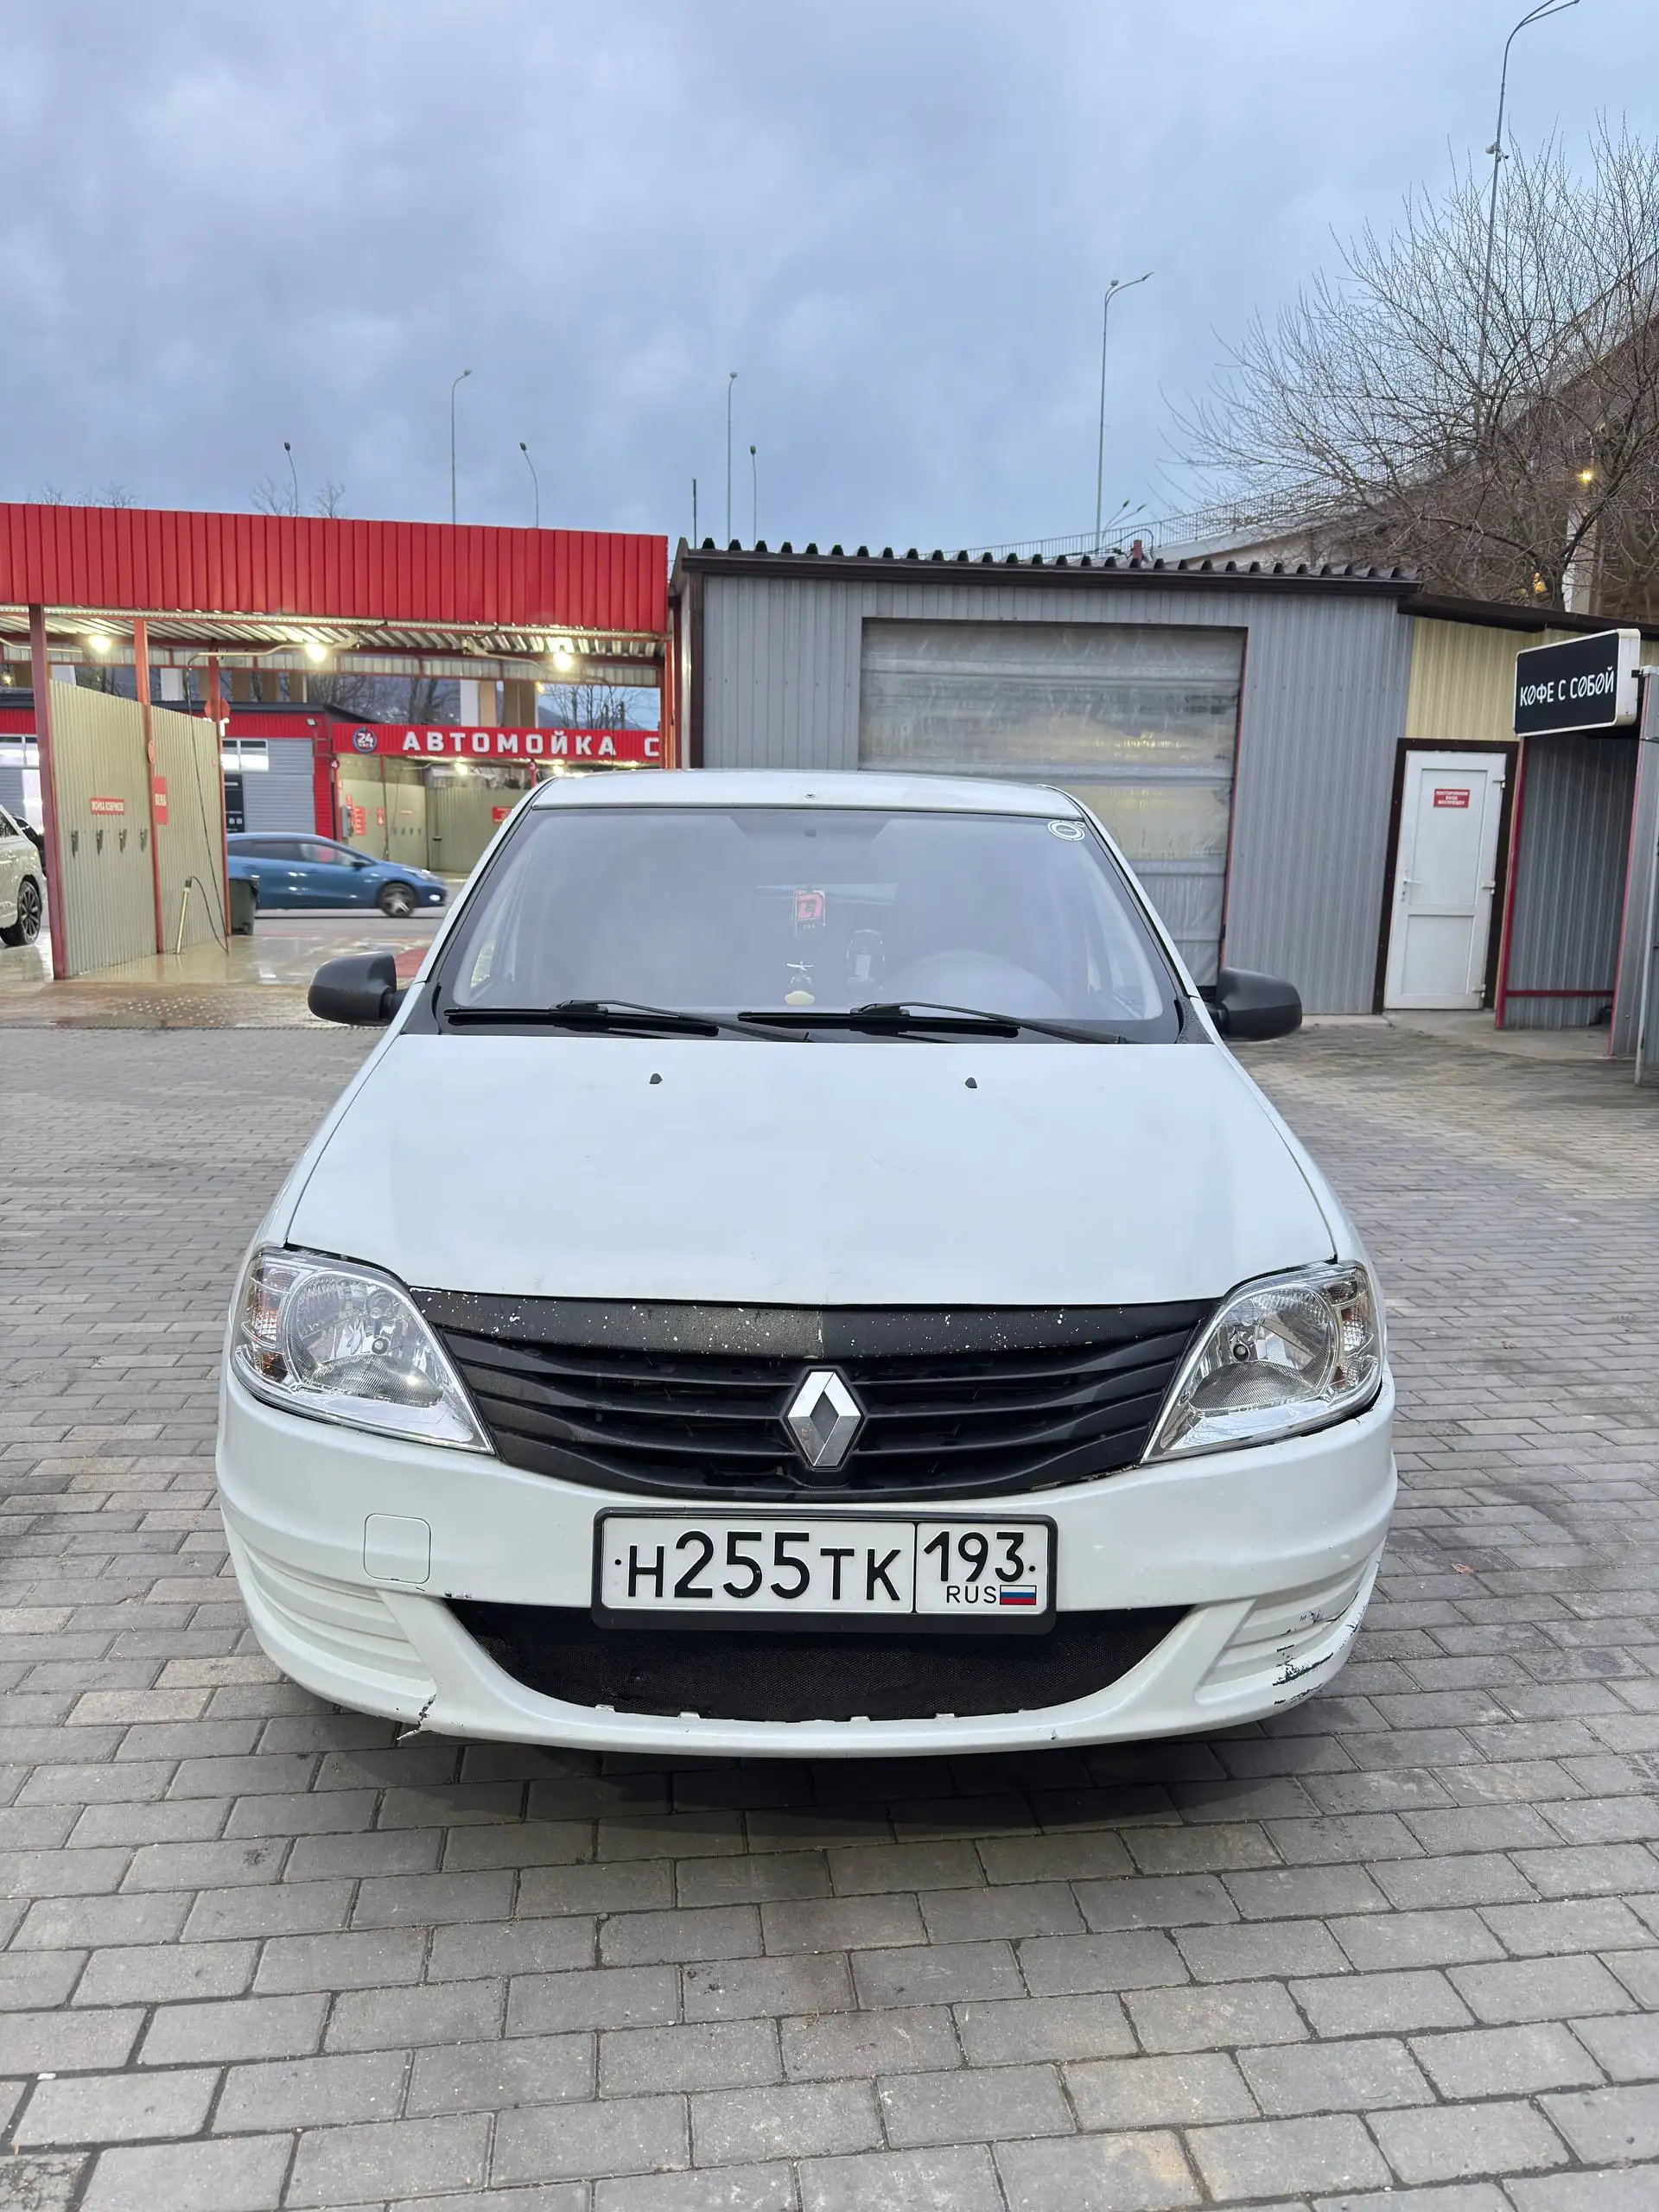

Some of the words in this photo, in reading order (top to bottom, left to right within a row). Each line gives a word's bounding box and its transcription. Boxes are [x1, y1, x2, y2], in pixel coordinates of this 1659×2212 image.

[1520, 681, 1554, 707] КОФЕ
[1558, 679, 1567, 701] С
[1570, 665, 1614, 699] СОБОЙ
[357, 733, 374, 743] 24
[403, 730, 616, 756] АВТОМОЙКА
[628, 1530, 901, 1601] Н255ТК
[923, 1530, 1025, 1583] 193
[946, 1586, 996, 1604] RUS
